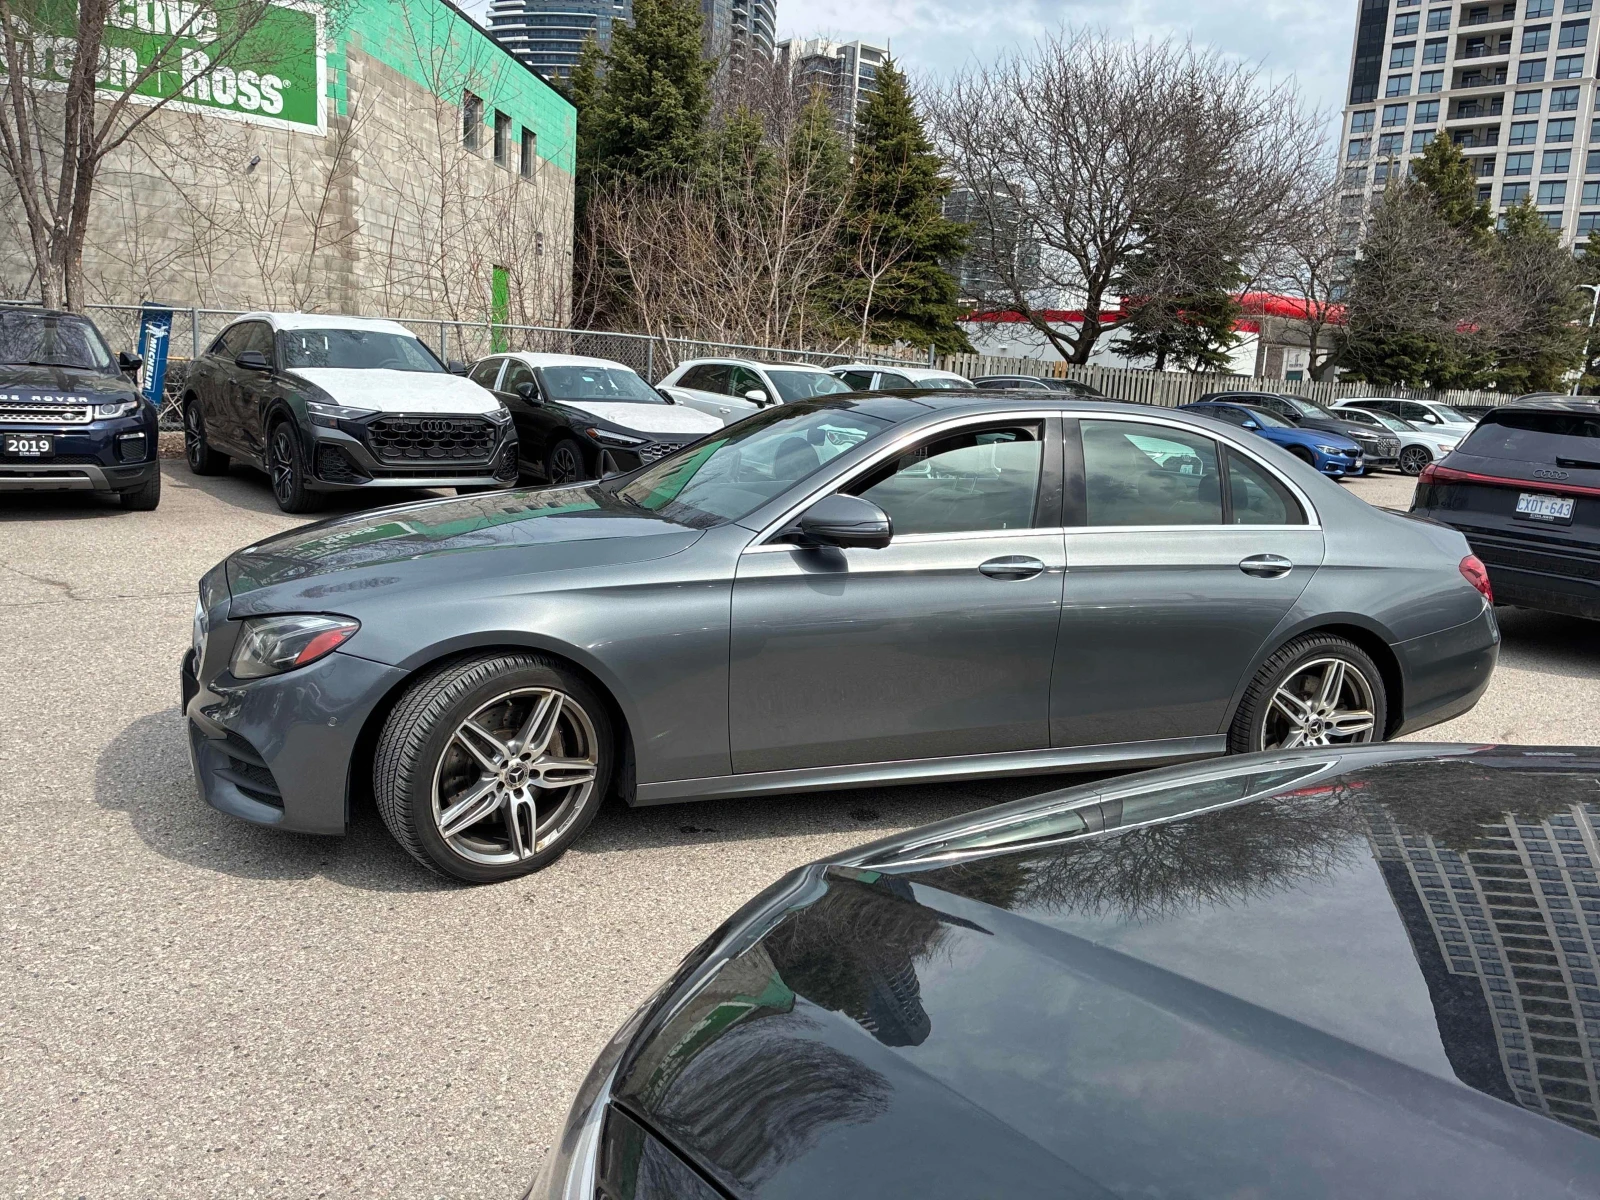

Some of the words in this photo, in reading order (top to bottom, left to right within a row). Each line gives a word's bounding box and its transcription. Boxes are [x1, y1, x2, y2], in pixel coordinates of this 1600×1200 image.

[76, 0, 217, 44] ctive
[181, 47, 284, 114] Ross
[144, 337, 158, 390] MICHELIN
[8, 439, 50, 452] 2019
